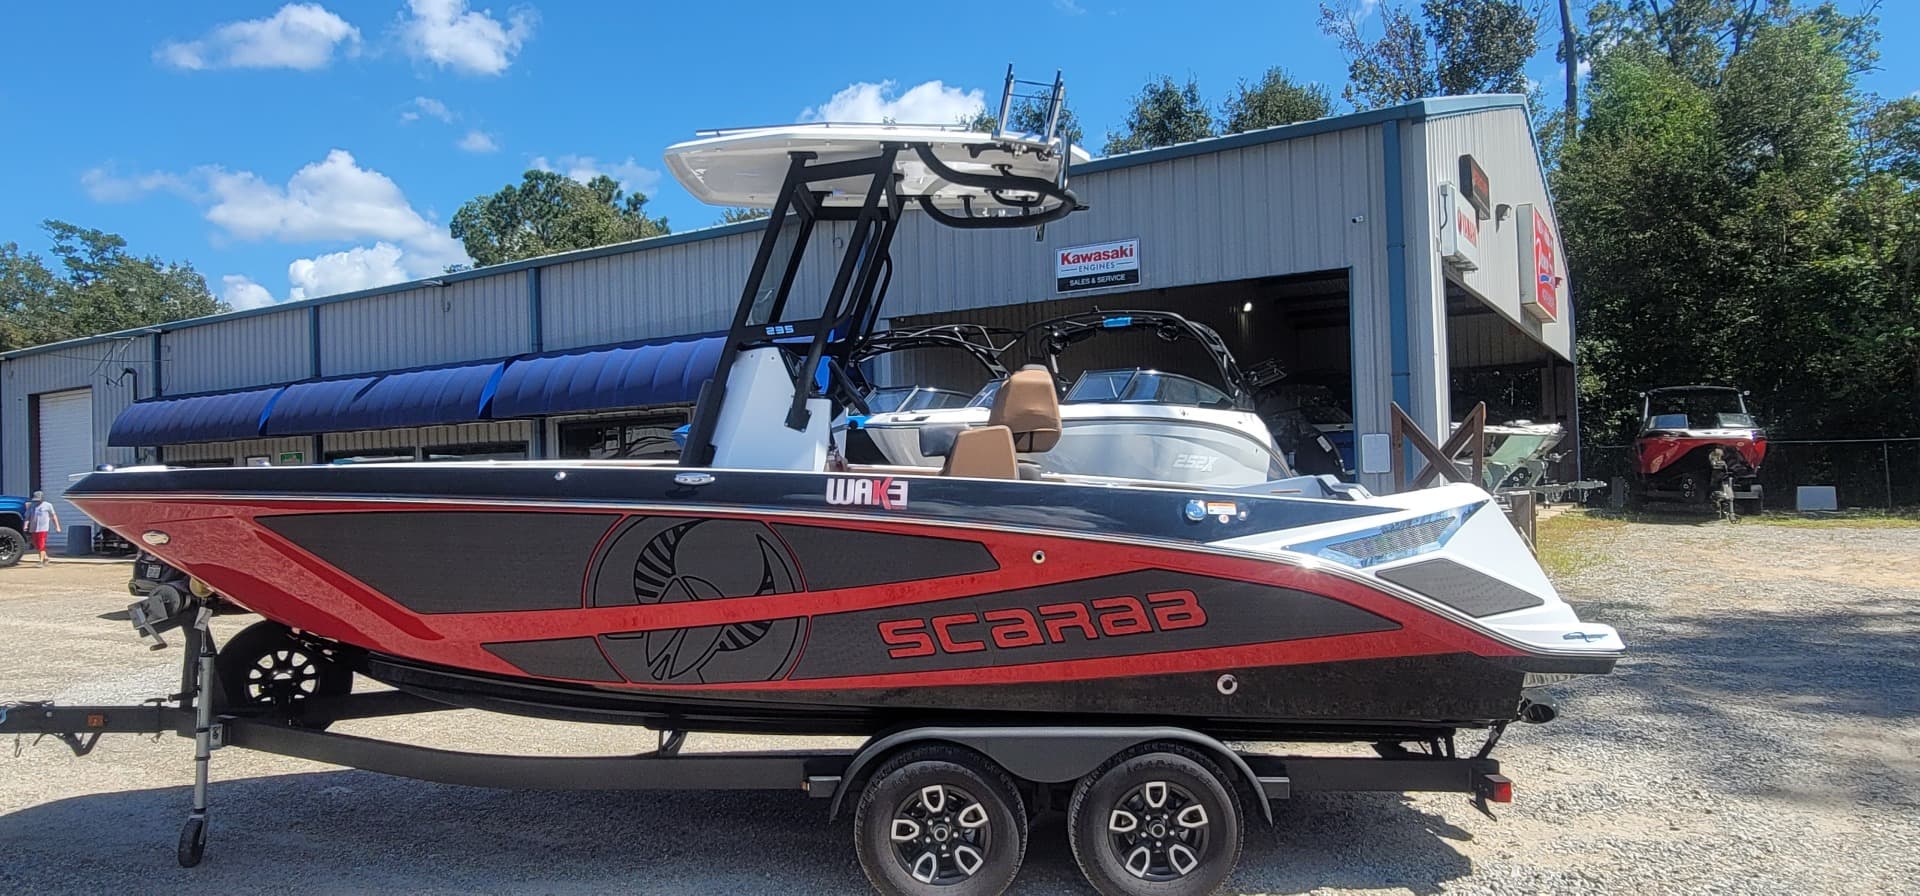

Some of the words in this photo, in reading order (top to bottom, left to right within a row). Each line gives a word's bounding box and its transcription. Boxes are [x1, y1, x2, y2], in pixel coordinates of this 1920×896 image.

[1061, 244, 1134, 265] Kawasaki
[1078, 262, 1116, 272] ENGINES
[1069, 278, 1090, 287] SALES
[1097, 274, 1126, 283] SERVICE
[765, 325, 795, 335] 235
[1173, 454, 1218, 472] 252X
[878, 589, 1208, 659] SCARAB
